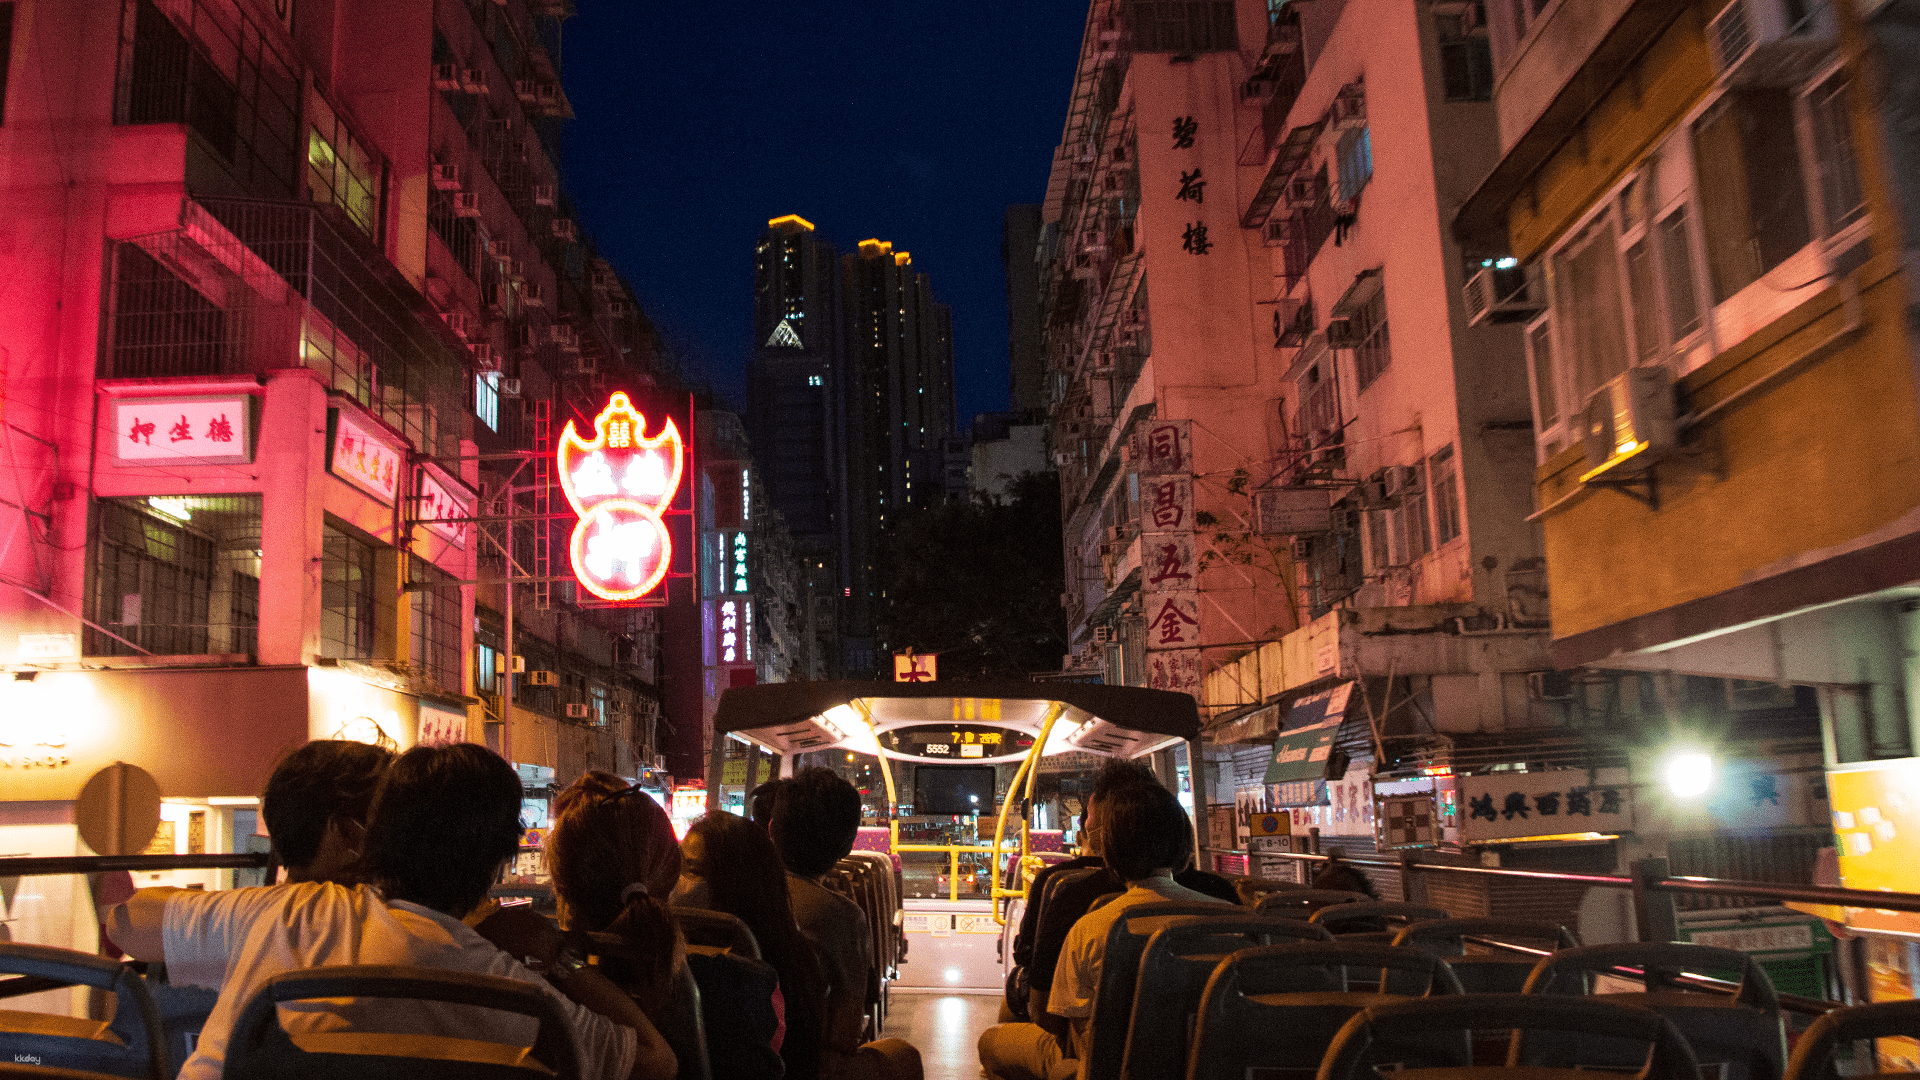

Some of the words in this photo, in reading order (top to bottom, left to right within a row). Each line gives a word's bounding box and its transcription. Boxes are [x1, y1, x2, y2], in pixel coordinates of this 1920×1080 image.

[1172, 115, 1214, 255] 碧荷樓
[1148, 424, 1198, 645] 同昌五金
[926, 743, 950, 754] 5552
